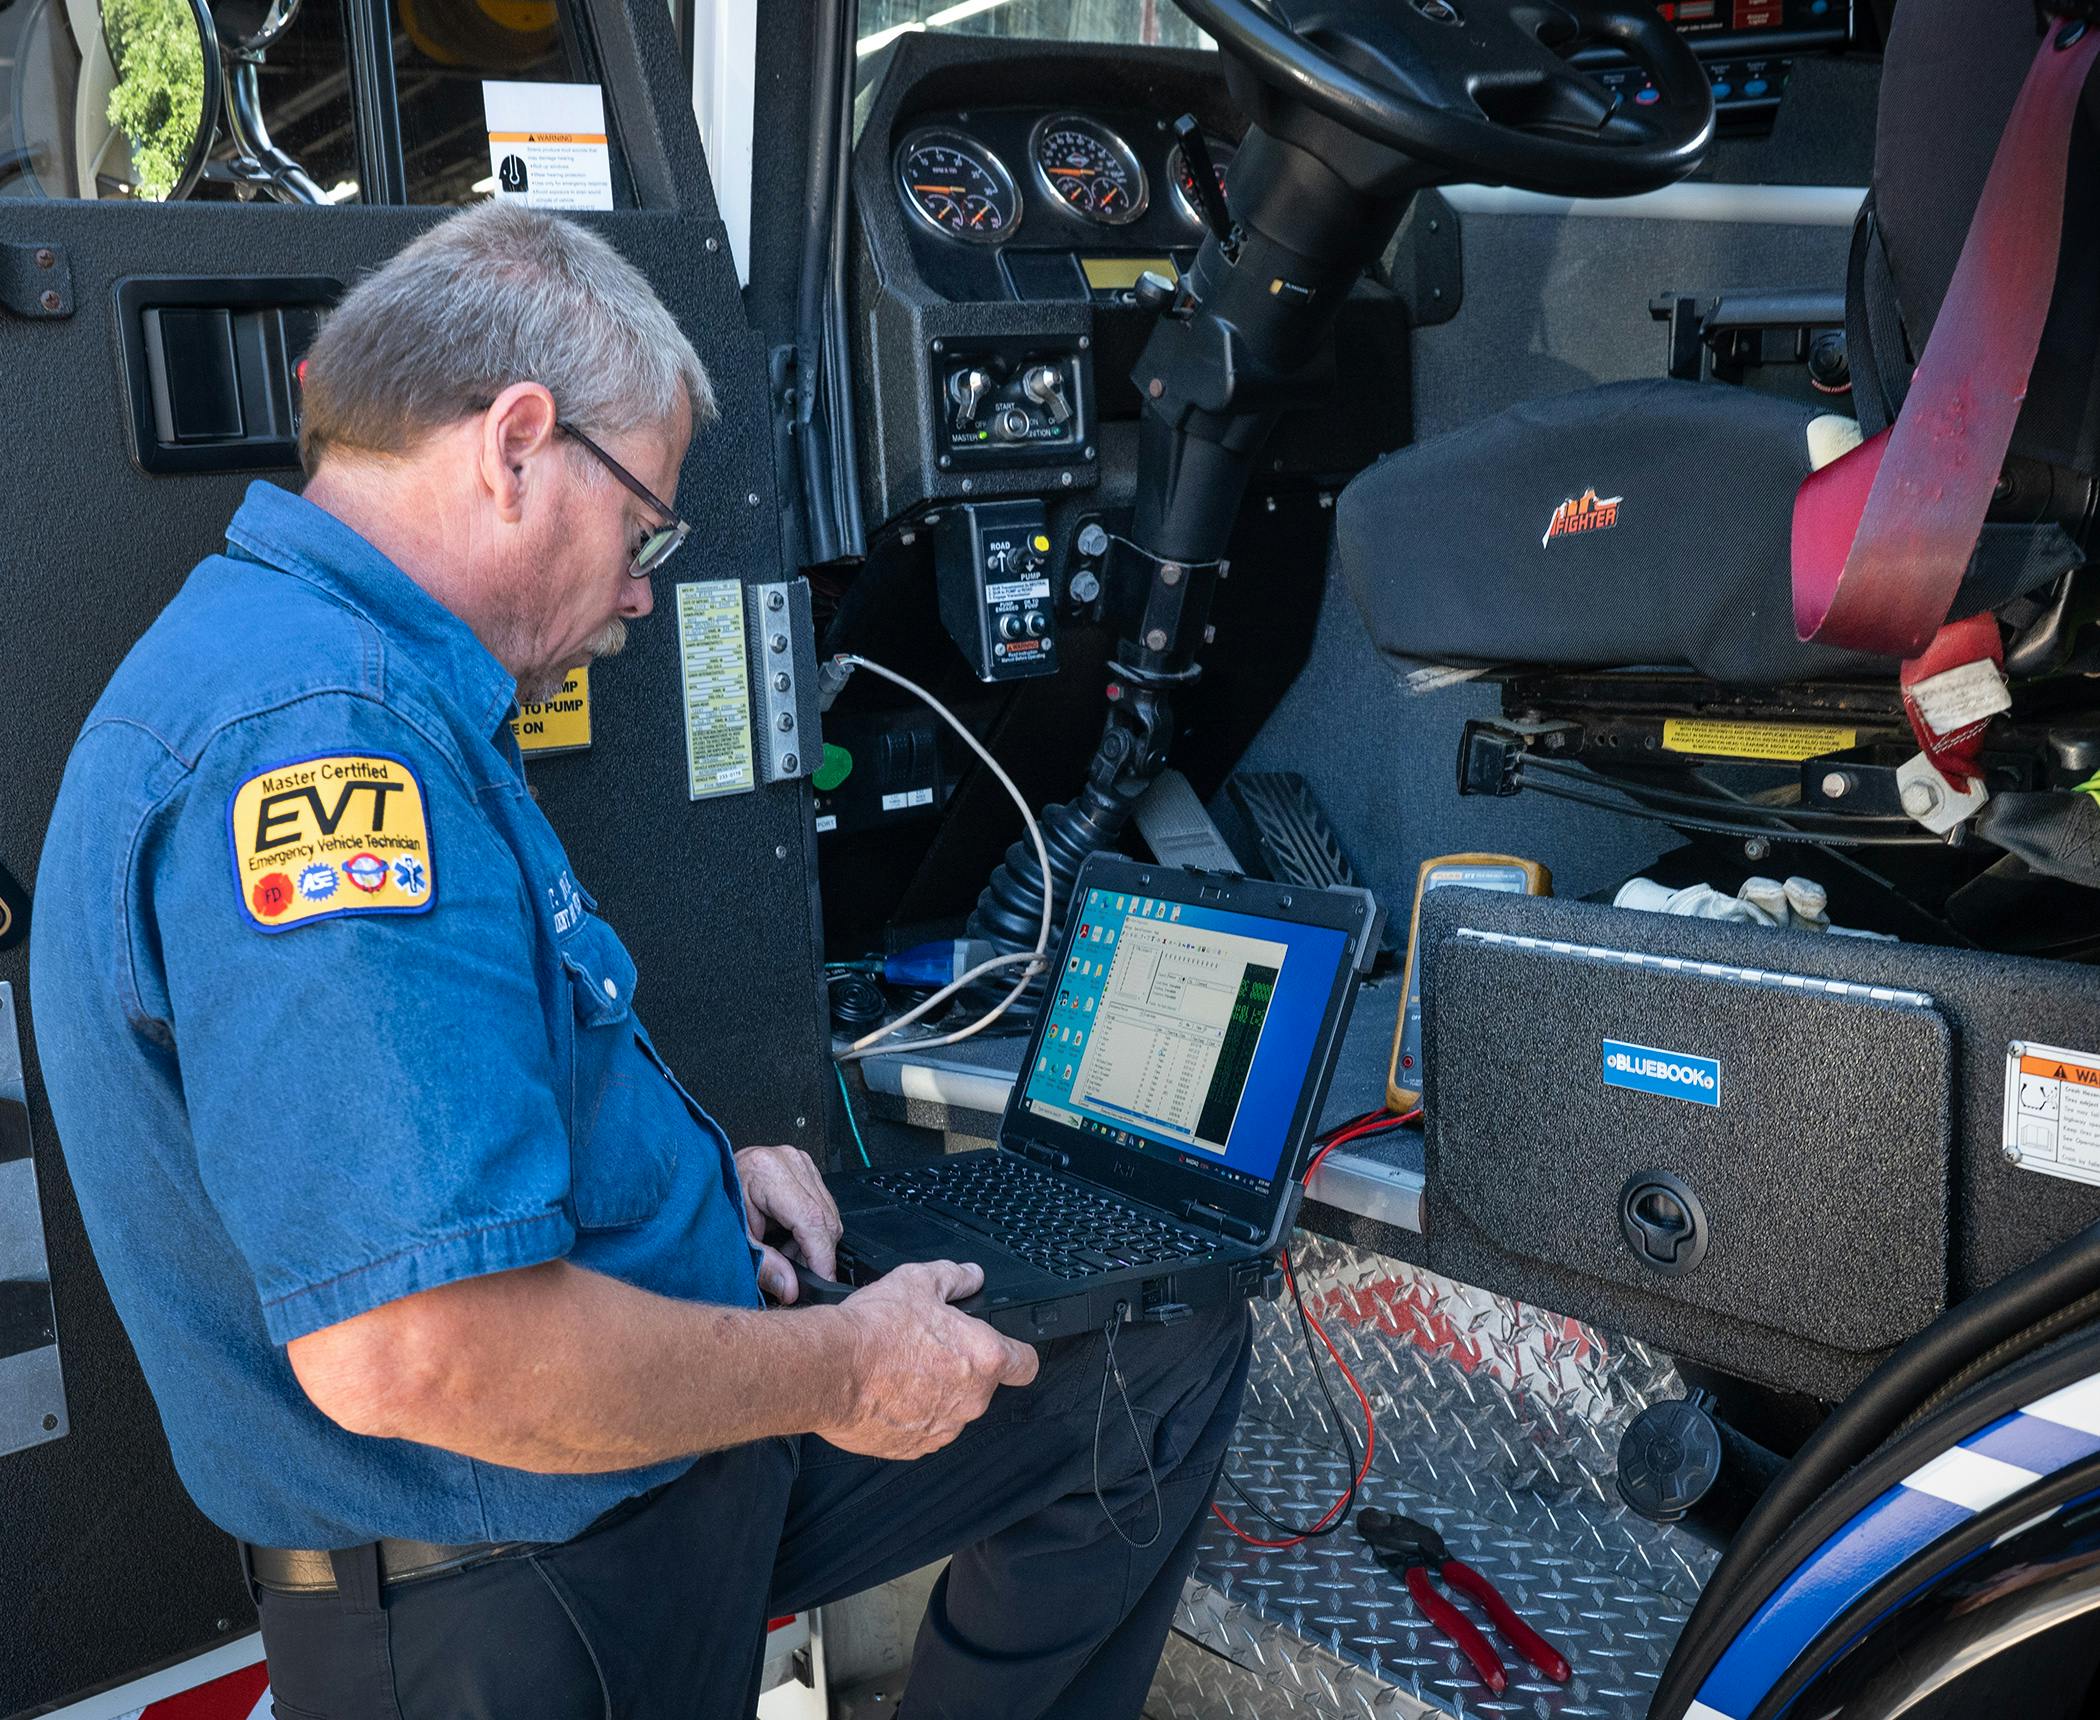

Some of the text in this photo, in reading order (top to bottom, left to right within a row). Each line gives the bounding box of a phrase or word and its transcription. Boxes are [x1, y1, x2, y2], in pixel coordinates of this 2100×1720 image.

[537, 135, 573, 143] WARNING
[995, 402, 1015, 411] START
[951, 433, 978, 442] MASTER
[1554, 507, 1617, 536] FIGHTER
[990, 541, 1011, 551] ROAD
[1020, 571, 1041, 581] PUMP
[561, 681, 578, 693] MP
[523, 700, 583, 715] TO PUMP
[511, 721, 544, 735] E ON
[262, 762, 389, 794] Master Certified
[255, 780, 404, 853] EVT
[248, 834, 421, 871] Emergency Vehicle Technician
[302, 870, 334, 894] ASE
[265, 887, 282, 904] FD
[1615, 1053, 1706, 1088] BLUEBOOK
[2076, 1068, 2100, 1087] WA
